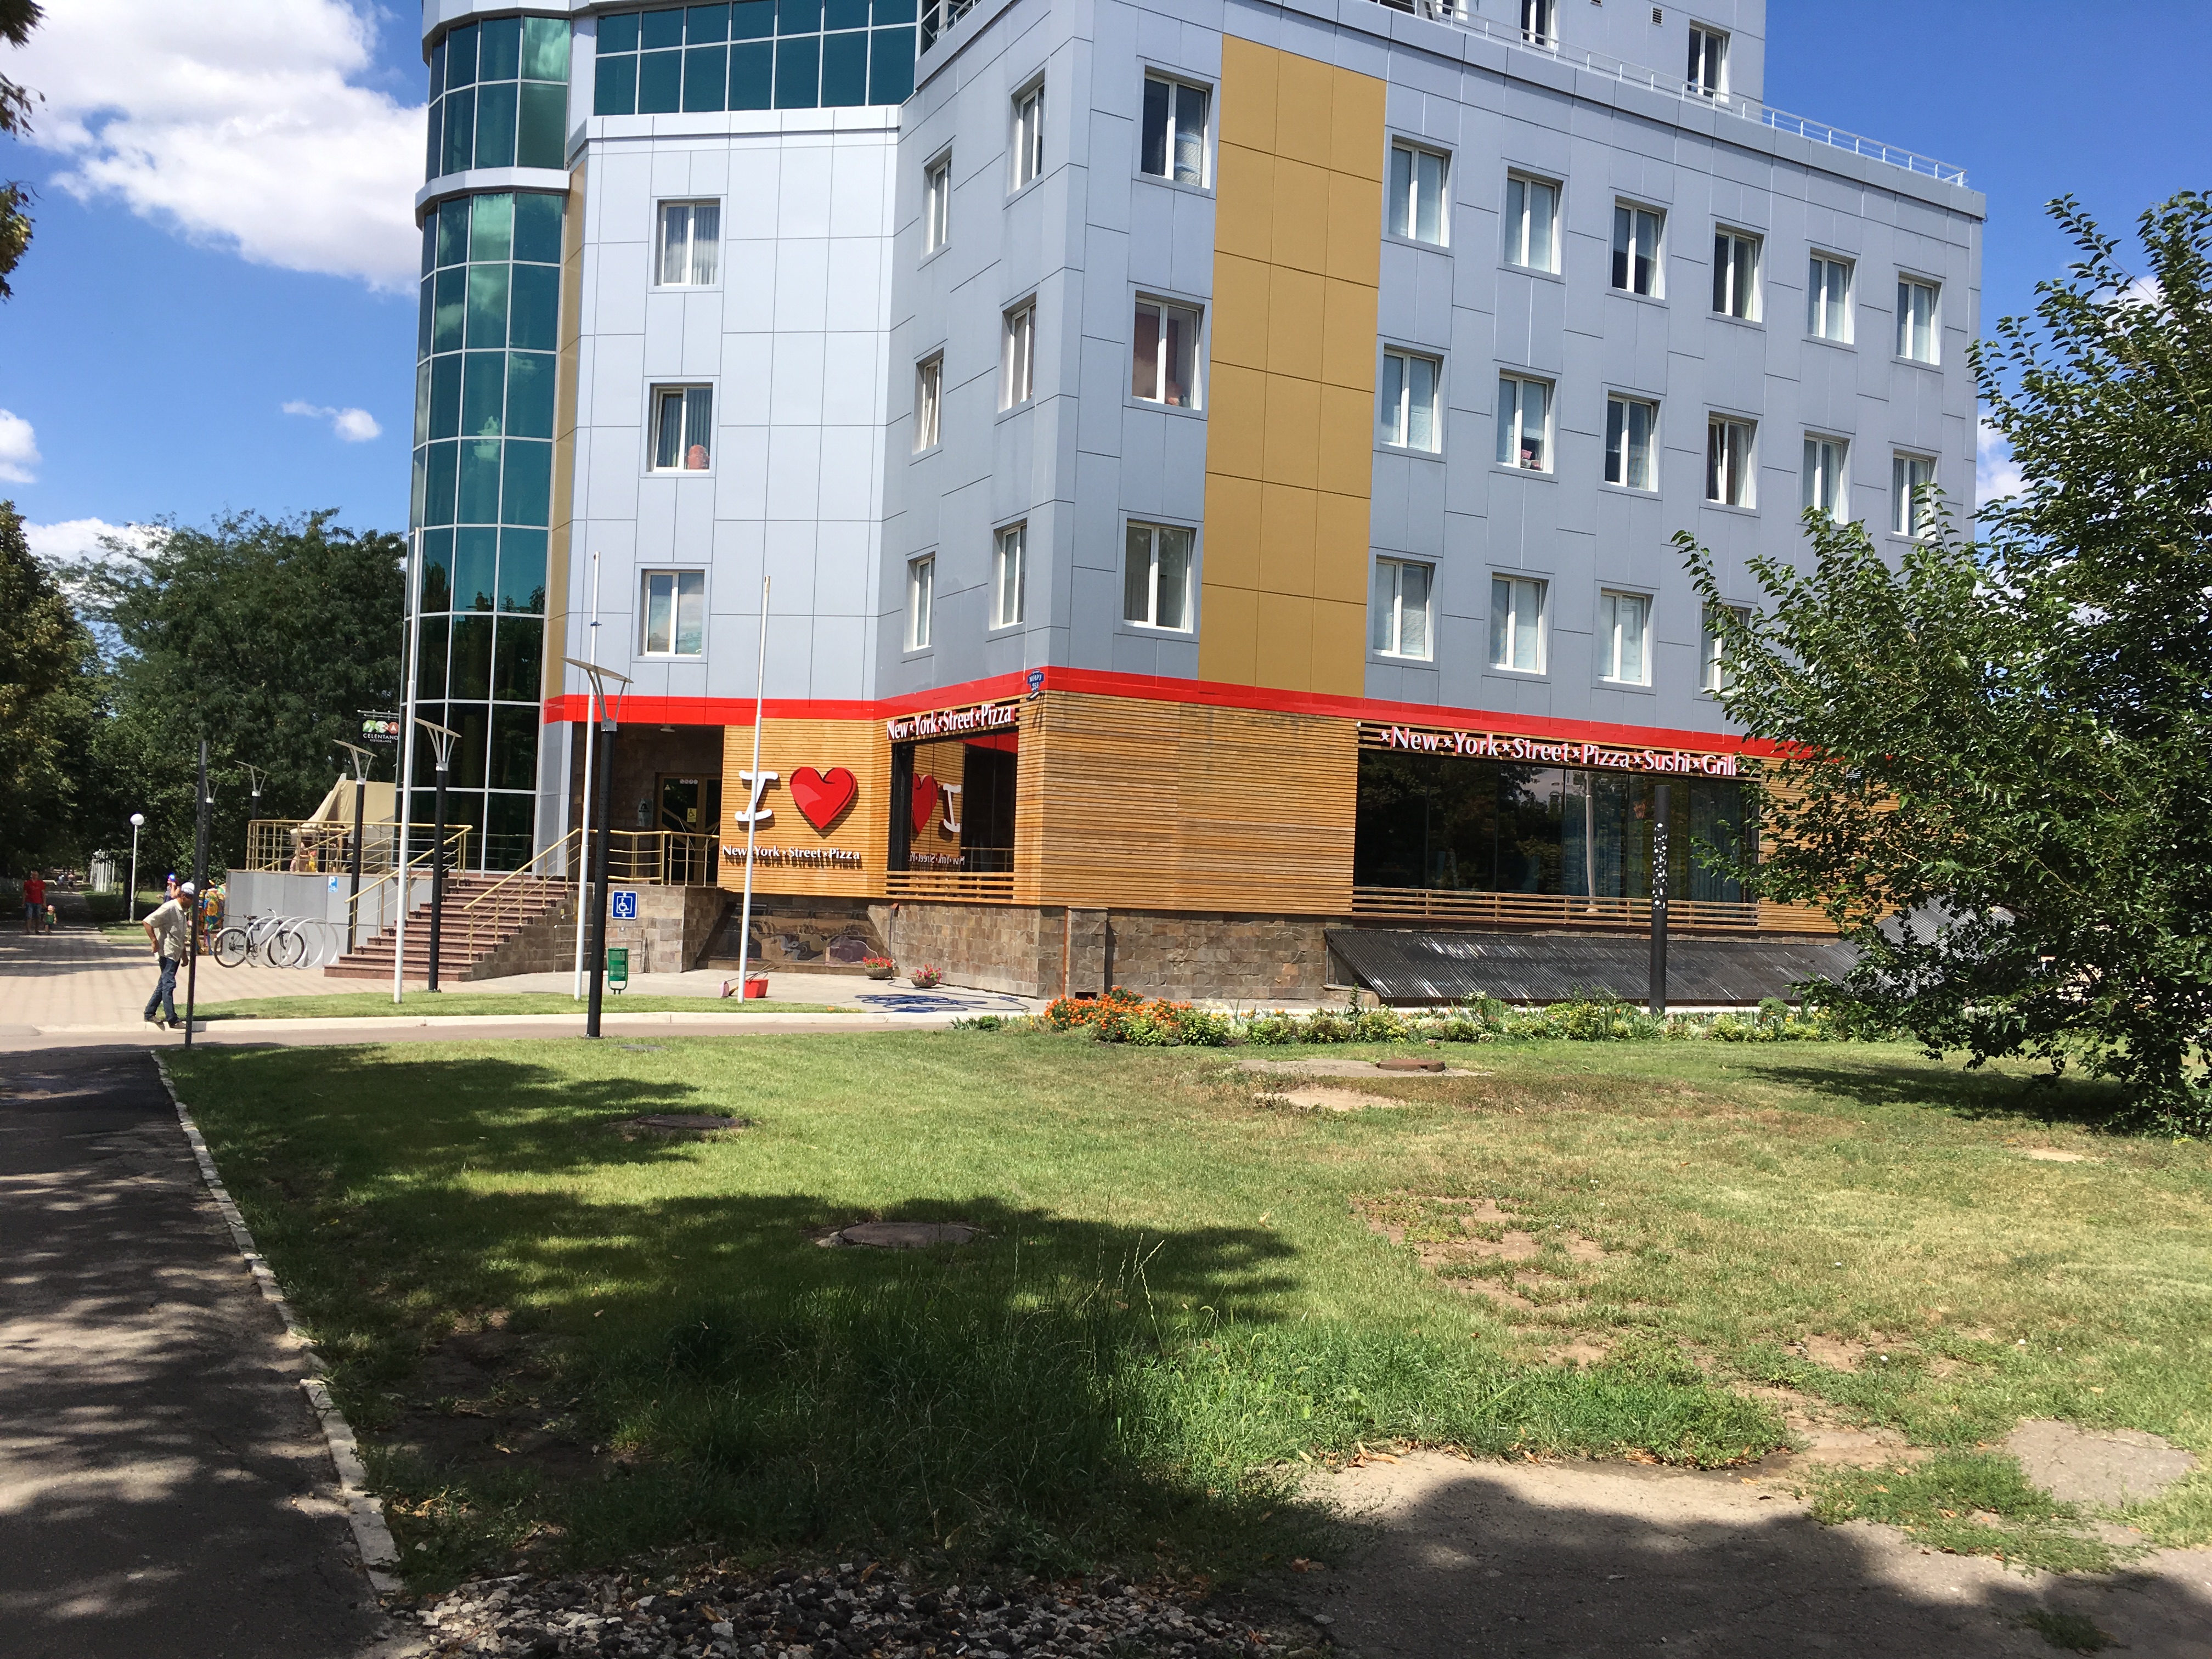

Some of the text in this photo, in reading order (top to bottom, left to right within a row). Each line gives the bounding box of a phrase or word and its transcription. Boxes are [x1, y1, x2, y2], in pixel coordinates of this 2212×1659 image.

[887, 703, 1014, 740] New York Street Pizza
[1390, 726, 1737, 776] New York Street Pizza Sushi Grill
[722, 845, 860, 860] New York Street Pizza
[329, 877, 336, 886] P
